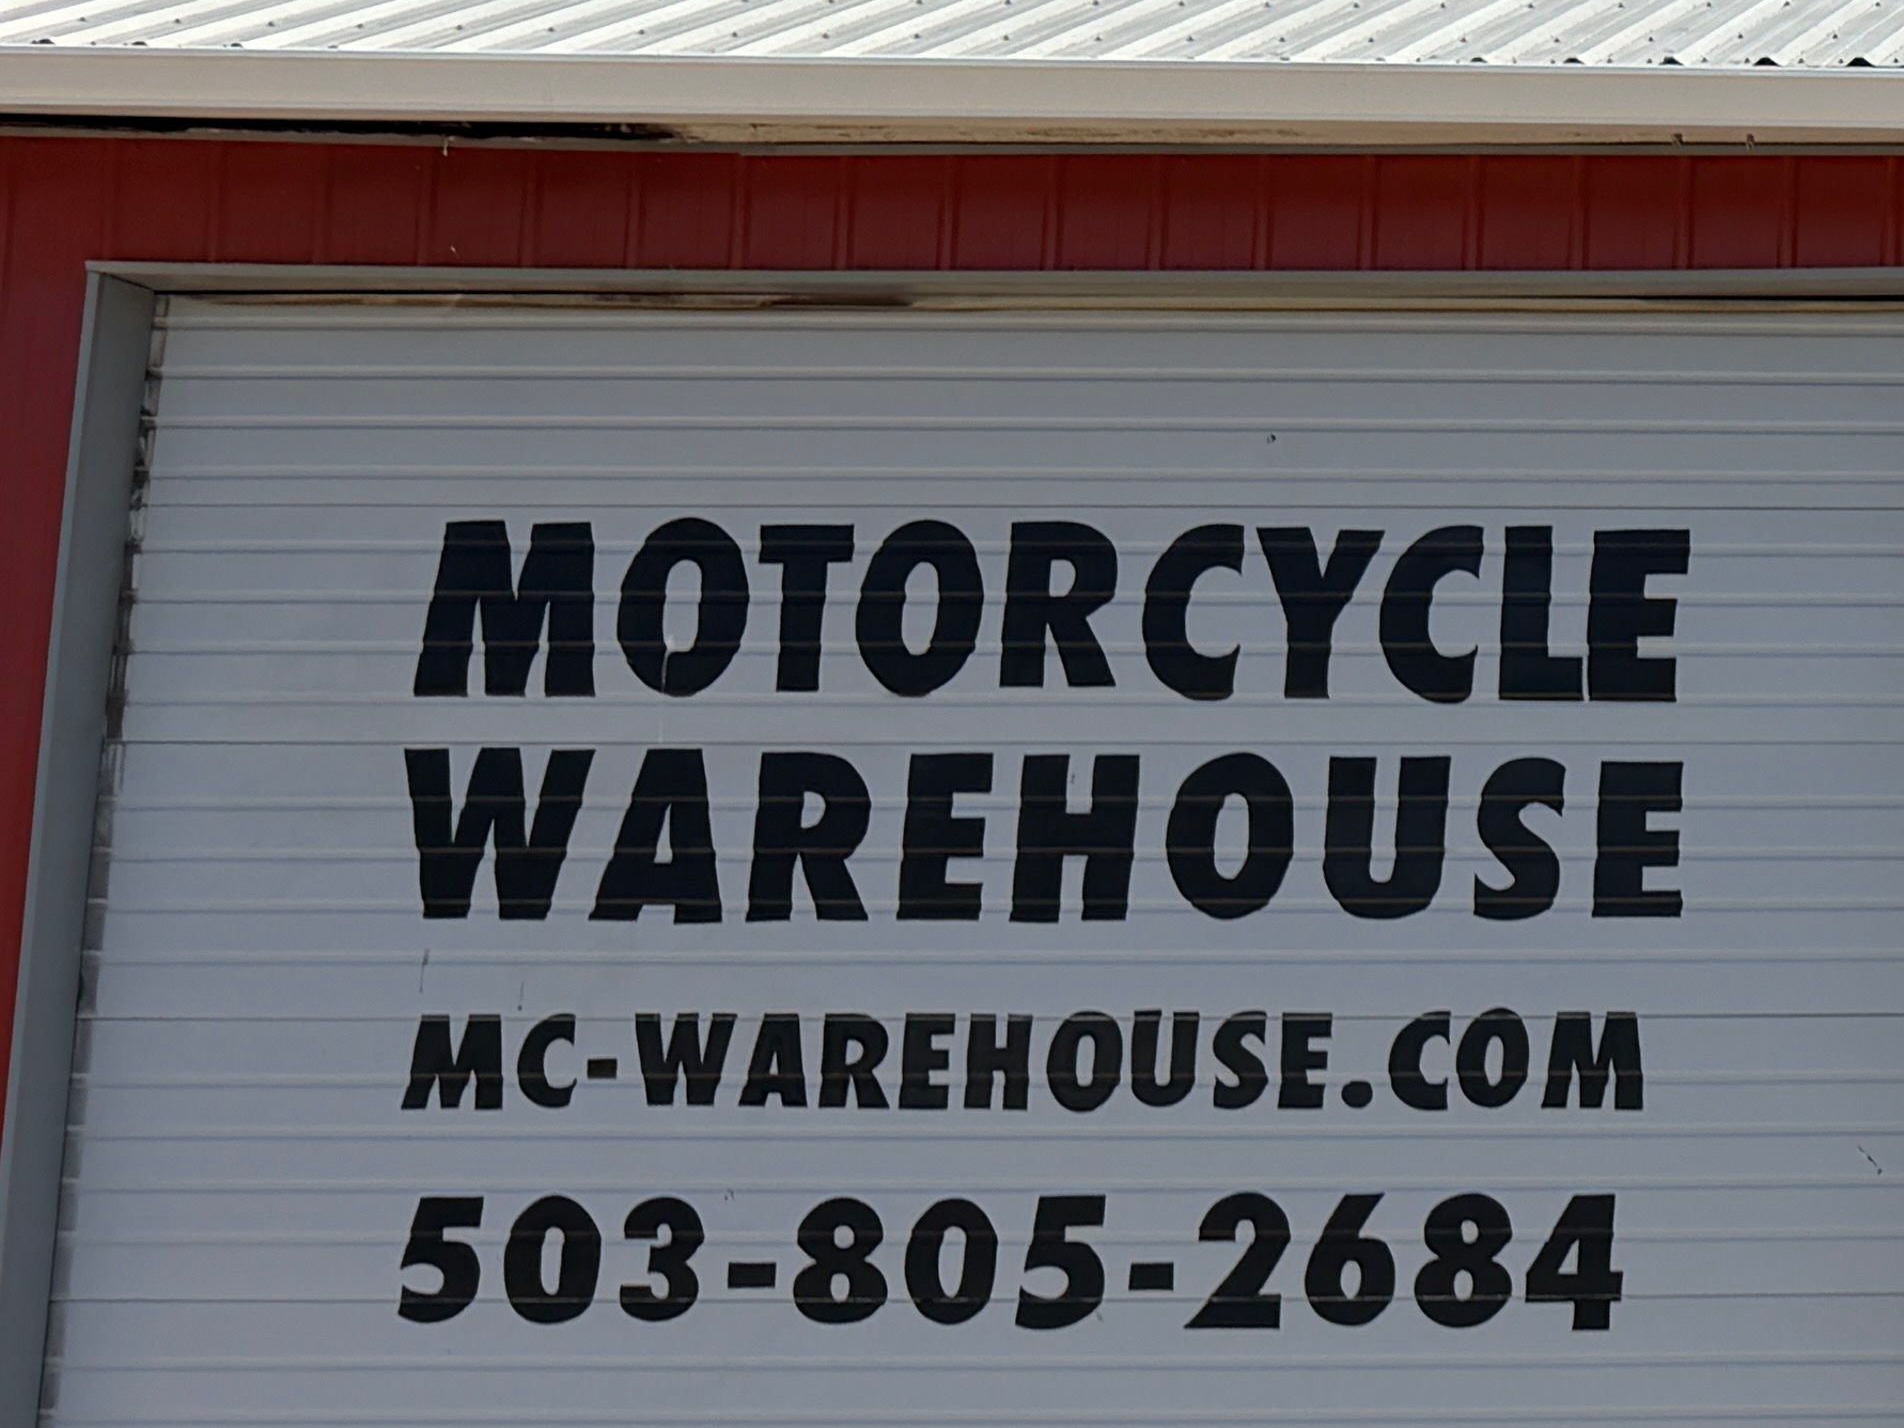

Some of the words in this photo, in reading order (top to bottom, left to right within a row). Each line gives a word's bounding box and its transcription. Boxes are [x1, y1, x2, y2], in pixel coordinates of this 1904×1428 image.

[414, 517, 1690, 704] MOTORCYCLE
[404, 748, 1684, 924] WAREHOUSE
[401, 1008, 1643, 1112] MC-WAREHOUSE.COM
[398, 1193, 1623, 1330] 503-805-2684
